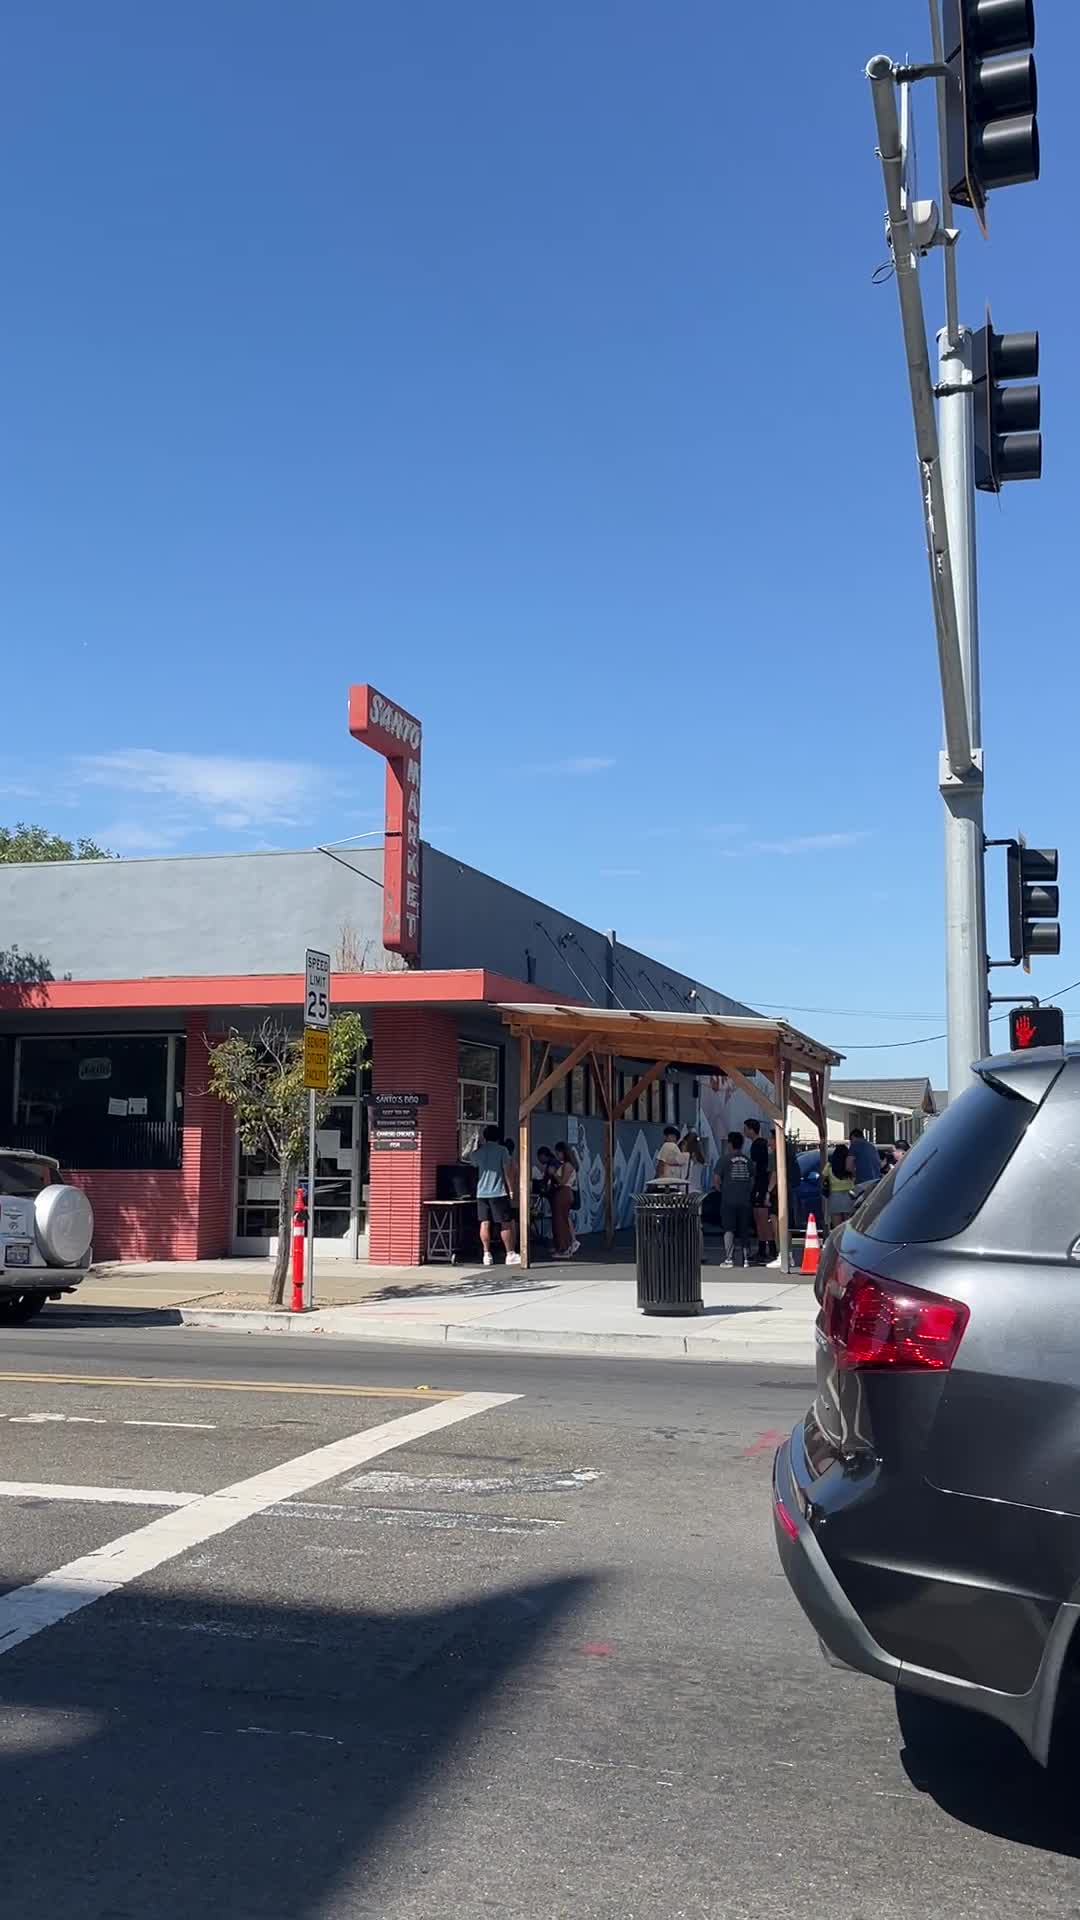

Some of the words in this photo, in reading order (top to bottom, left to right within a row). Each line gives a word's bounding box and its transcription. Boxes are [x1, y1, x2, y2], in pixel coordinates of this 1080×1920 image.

[370, 694, 420, 750] SANTO
[406, 757, 420, 938] MARKET
[308, 956, 328, 972] SPEED
[310, 975, 326, 988] LIMIT
[308, 991, 327, 1019] 25
[307, 1036, 326, 1048] SENIOR
[307, 1052, 326, 1064] CITIZEN
[306, 1068, 326, 1081] FACILITY
[375, 1095, 403, 1104] SANTO'S
[404, 1095, 419, 1104] BBQ
